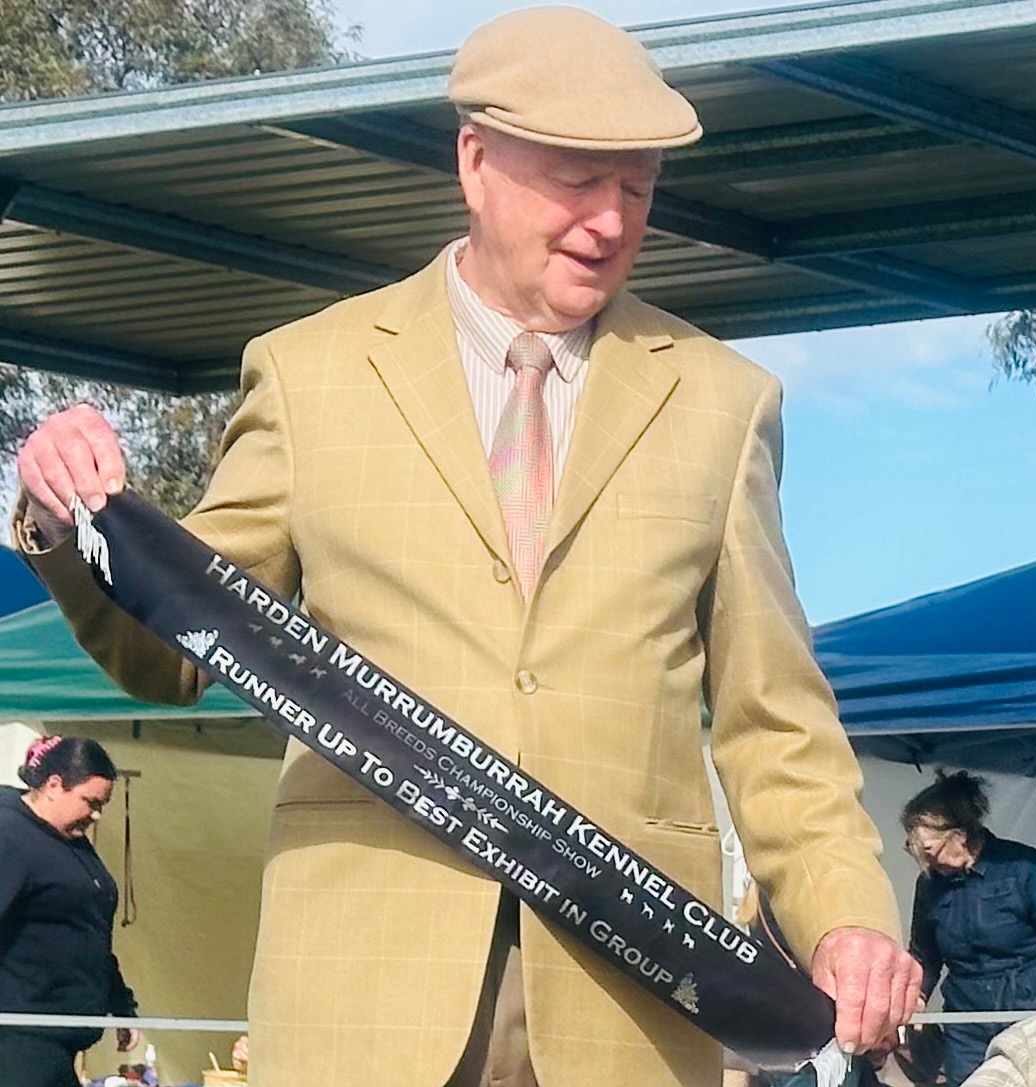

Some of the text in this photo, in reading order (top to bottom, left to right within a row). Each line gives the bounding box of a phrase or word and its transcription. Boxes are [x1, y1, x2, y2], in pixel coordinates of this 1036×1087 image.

[206, 554, 759, 964] HARDEN MURRUMBURRAH KENNEL CLUB
[209, 646, 673, 985] RUNNER UP TO BEST EXHIBIT IN GROUP
[343, 689, 602, 879] ALL BREEDS CHAMPIONSHIP SHOW
